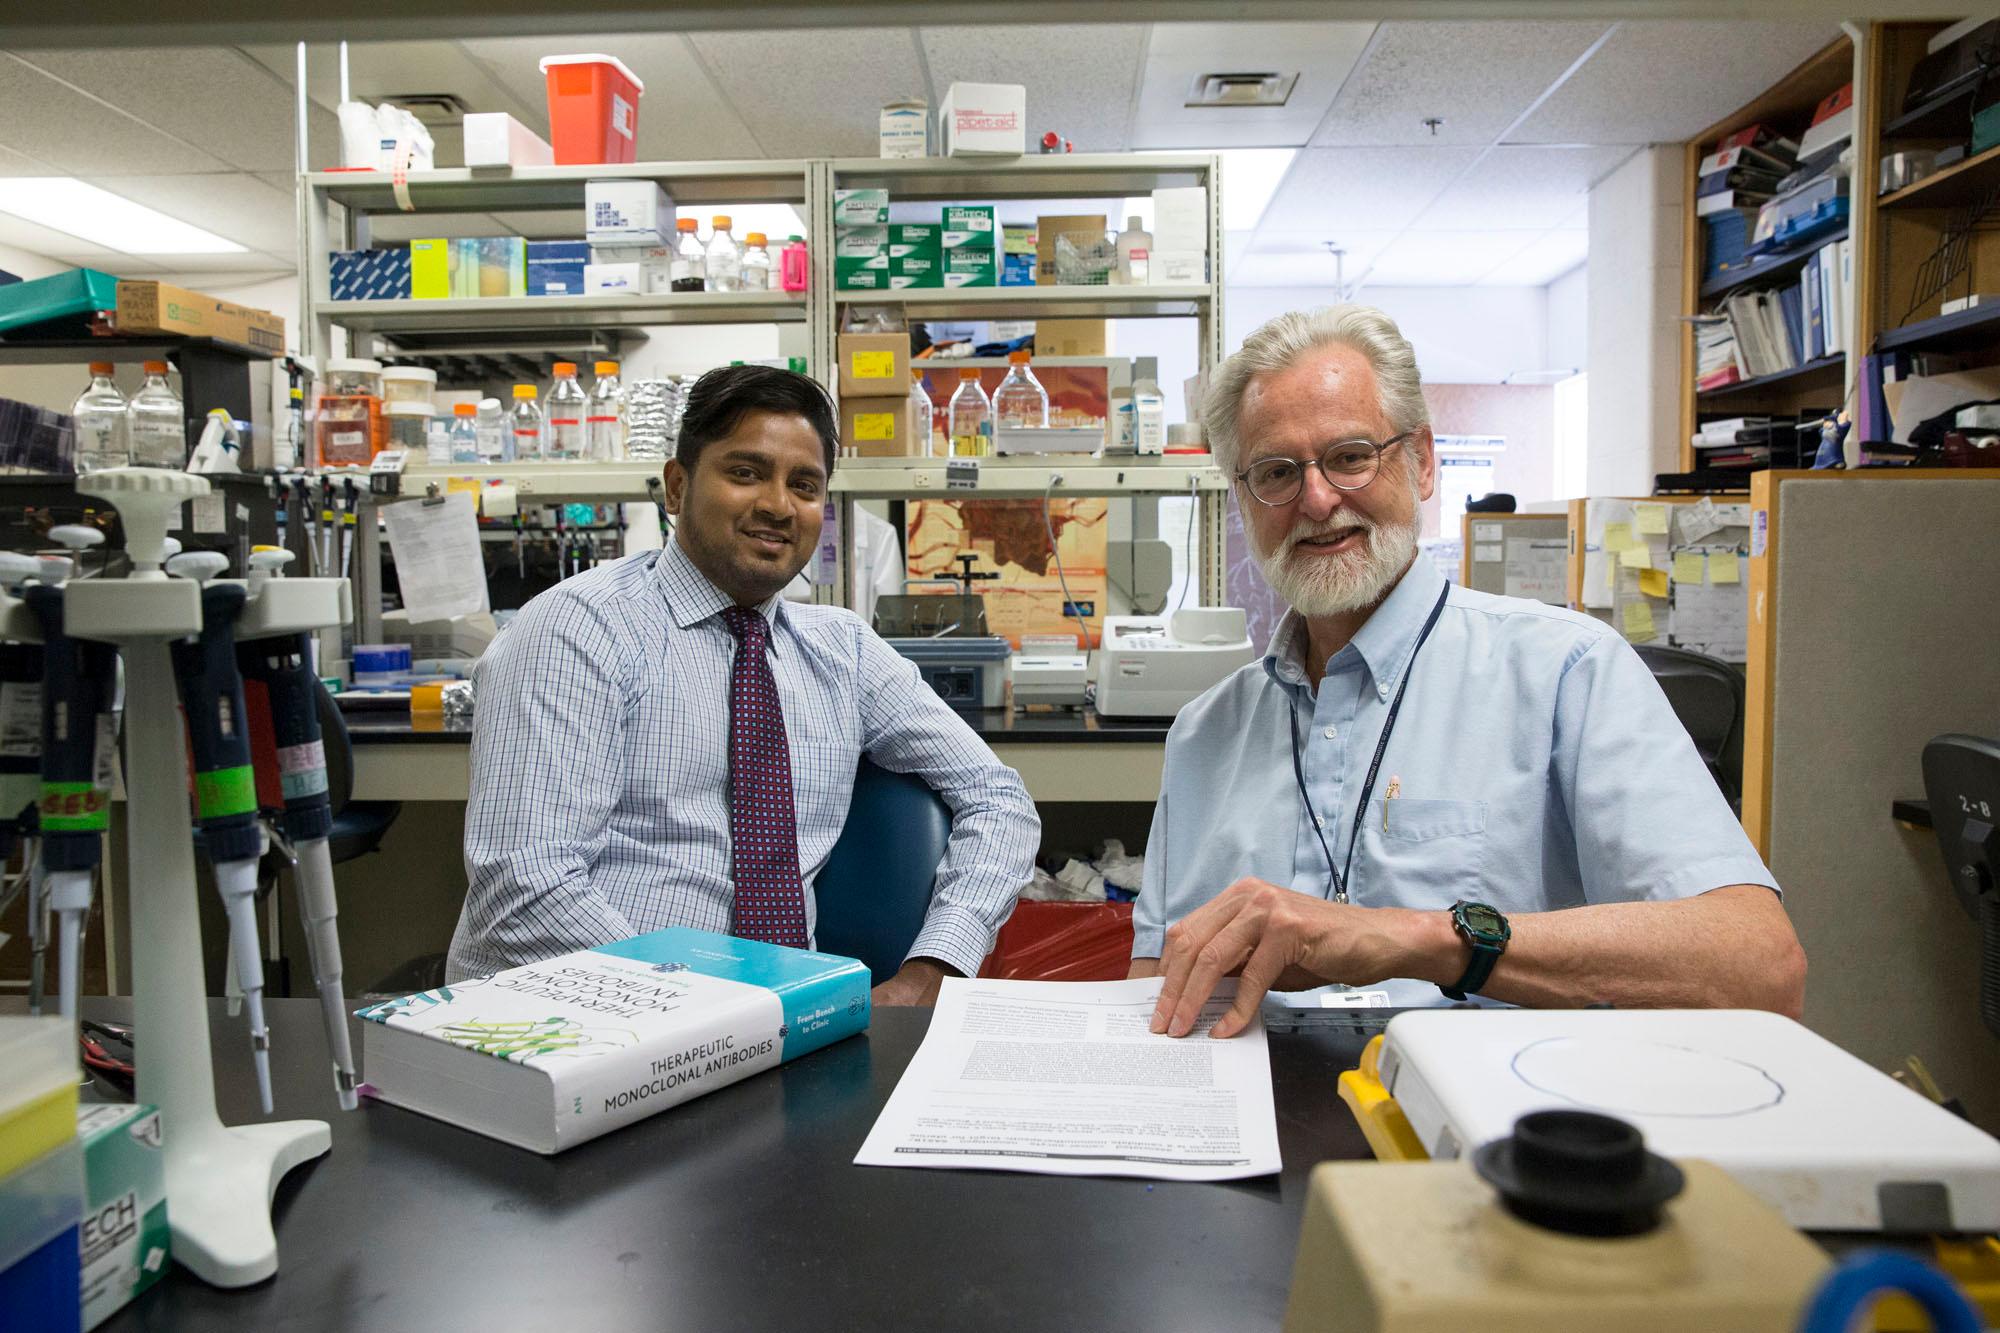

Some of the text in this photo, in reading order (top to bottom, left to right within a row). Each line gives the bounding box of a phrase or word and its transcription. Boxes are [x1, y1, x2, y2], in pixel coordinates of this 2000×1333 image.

[949, 210, 988, 218] KIMTECH
[495, 979, 644, 1019] THERAPEUTIC
[522, 970, 681, 1013] MONOCLONAL
[554, 967, 688, 999] ANTIBODIES
[797, 1005, 836, 1025] From Bench
[802, 1019, 830, 1034] to Clinic
[651, 1035, 735, 1076] THERAPEUTIC
[604, 1039, 773, 1112] MONOCLONAL ANTIBODIES
